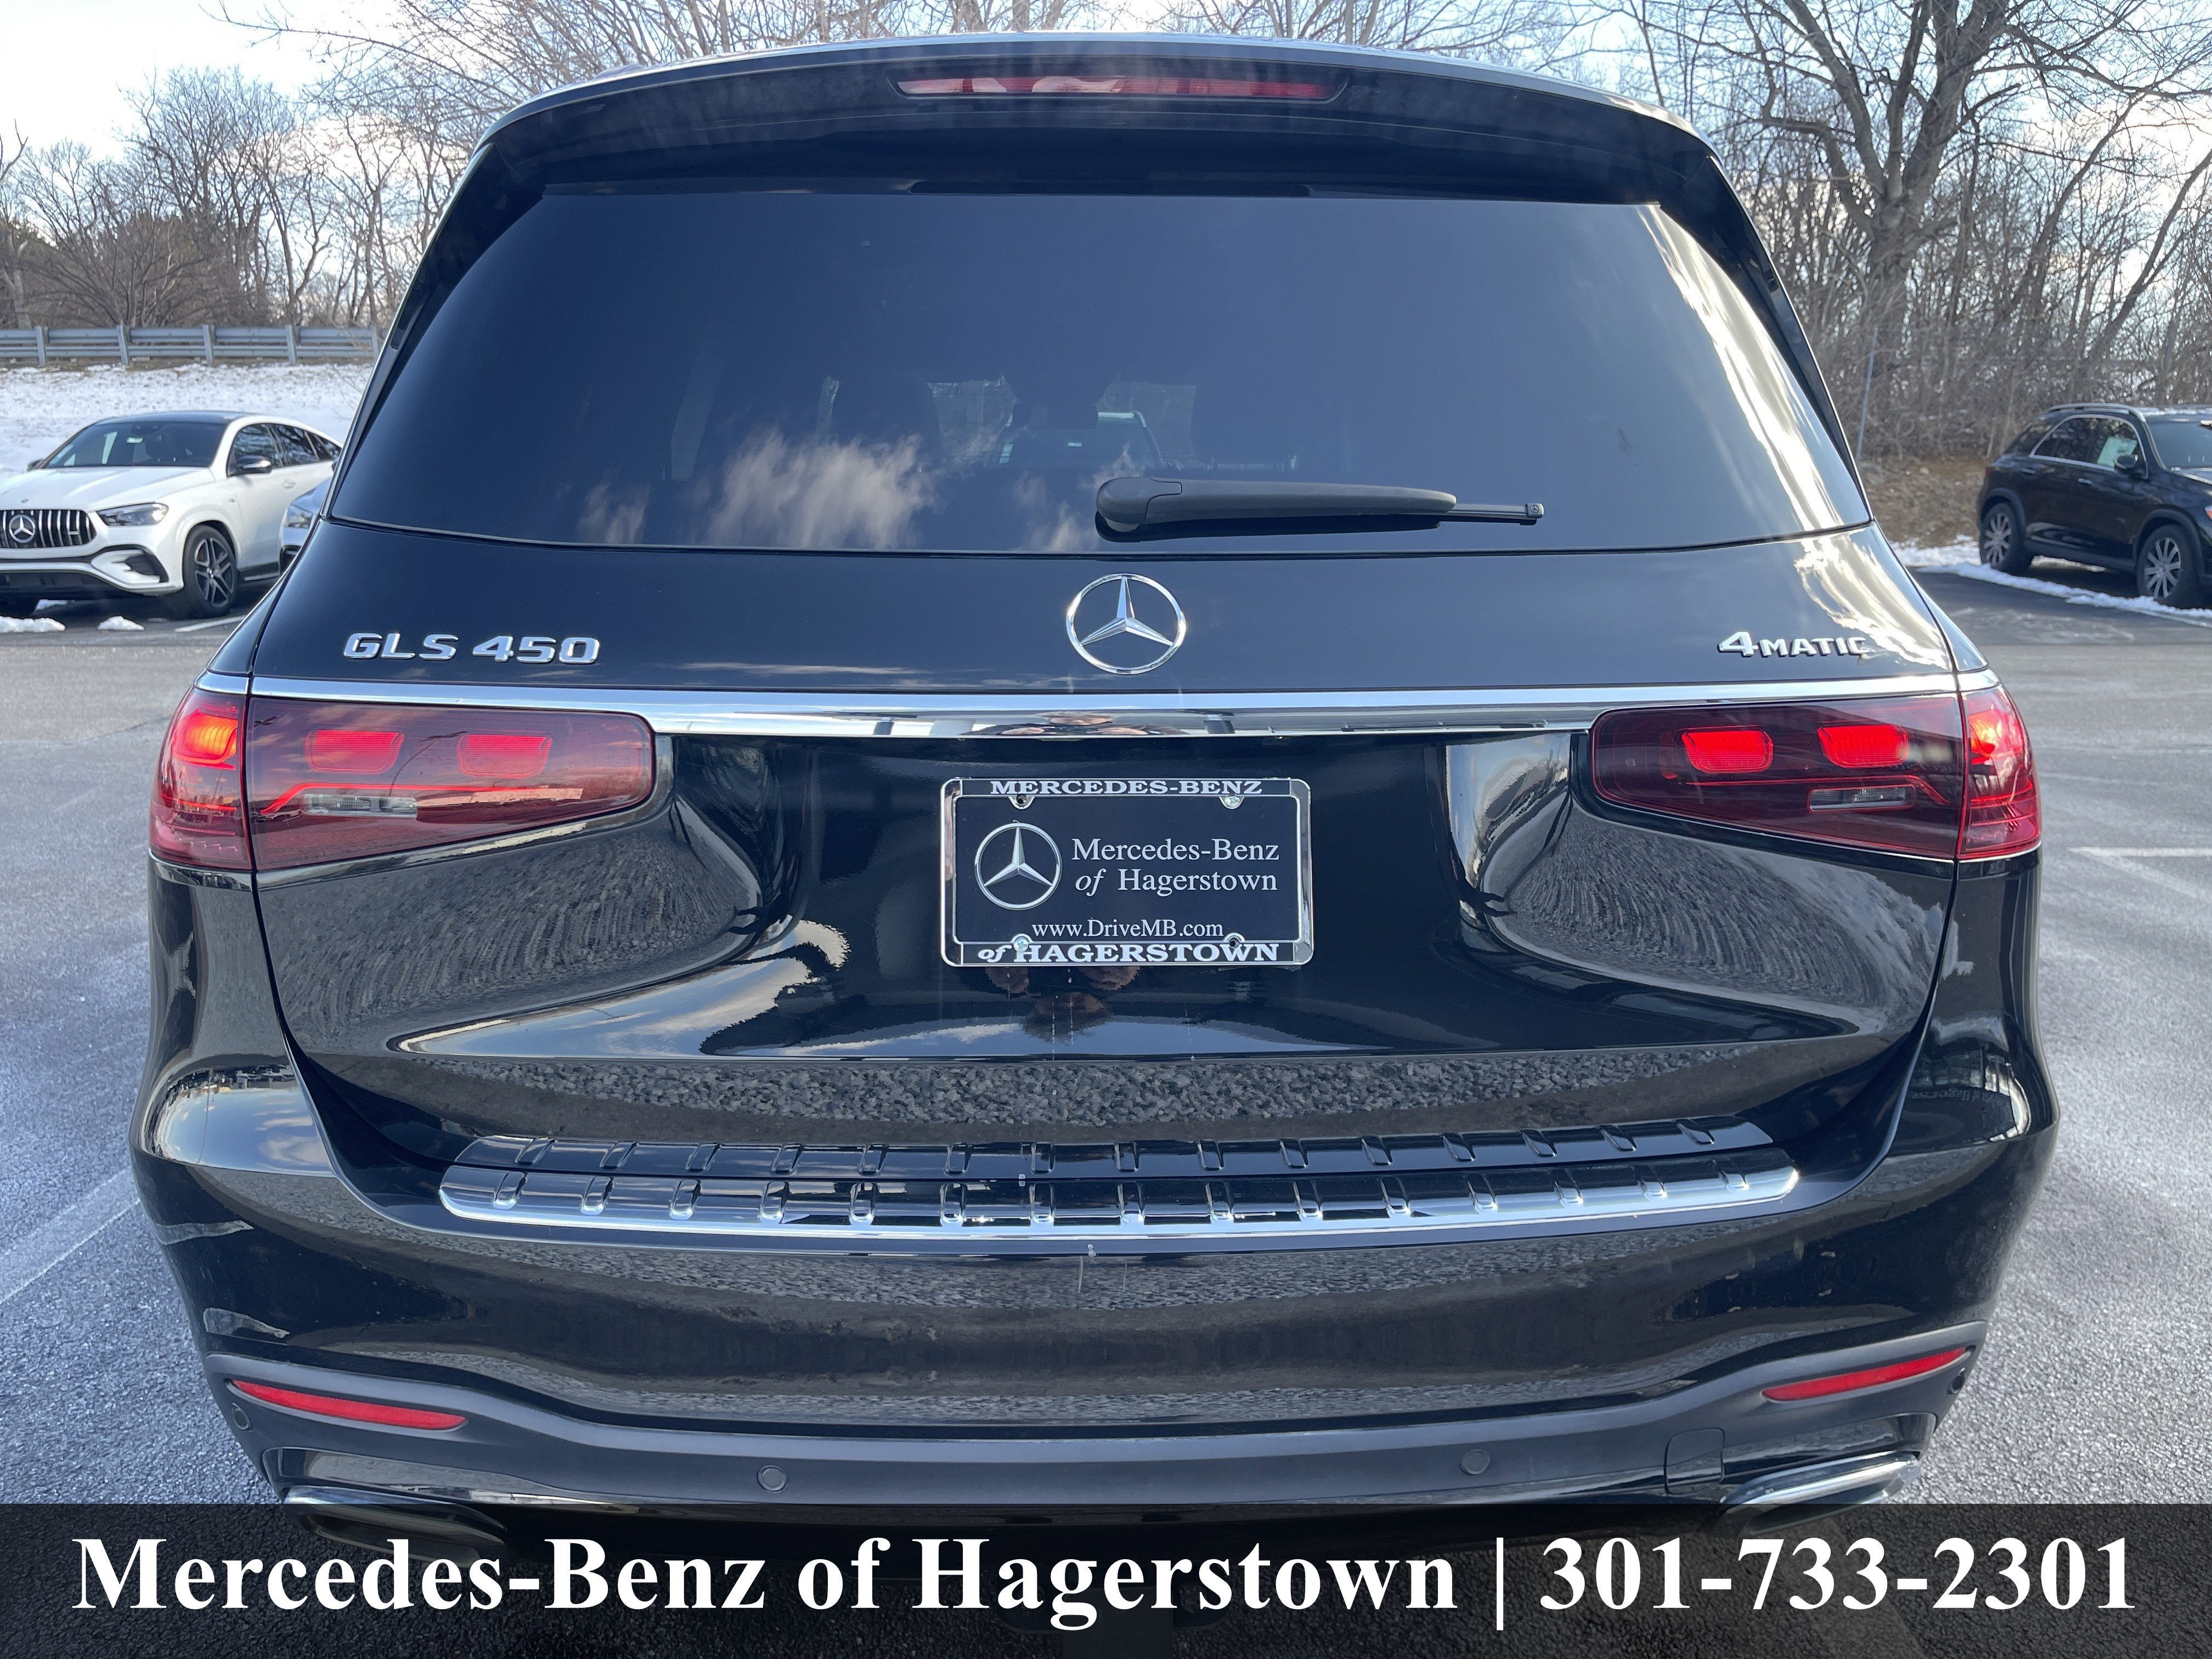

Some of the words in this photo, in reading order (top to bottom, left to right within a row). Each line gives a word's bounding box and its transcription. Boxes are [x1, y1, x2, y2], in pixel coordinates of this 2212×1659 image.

[342, 633, 459, 660] GLS
[472, 635, 600, 664] 450
[1717, 631, 1870, 658] 4MATIC
[990, 780, 1263, 795] MERCEDES-BENZ
[1071, 838, 1280, 861] Mercedes-Benz
[1075, 868, 1107, 897] of
[1117, 868, 1279, 898] Hagerstown
[1032, 918, 1224, 937] www.DriveMB.com
[978, 945, 1012, 963] of
[1013, 944, 1279, 962] HAGERSTOWN
